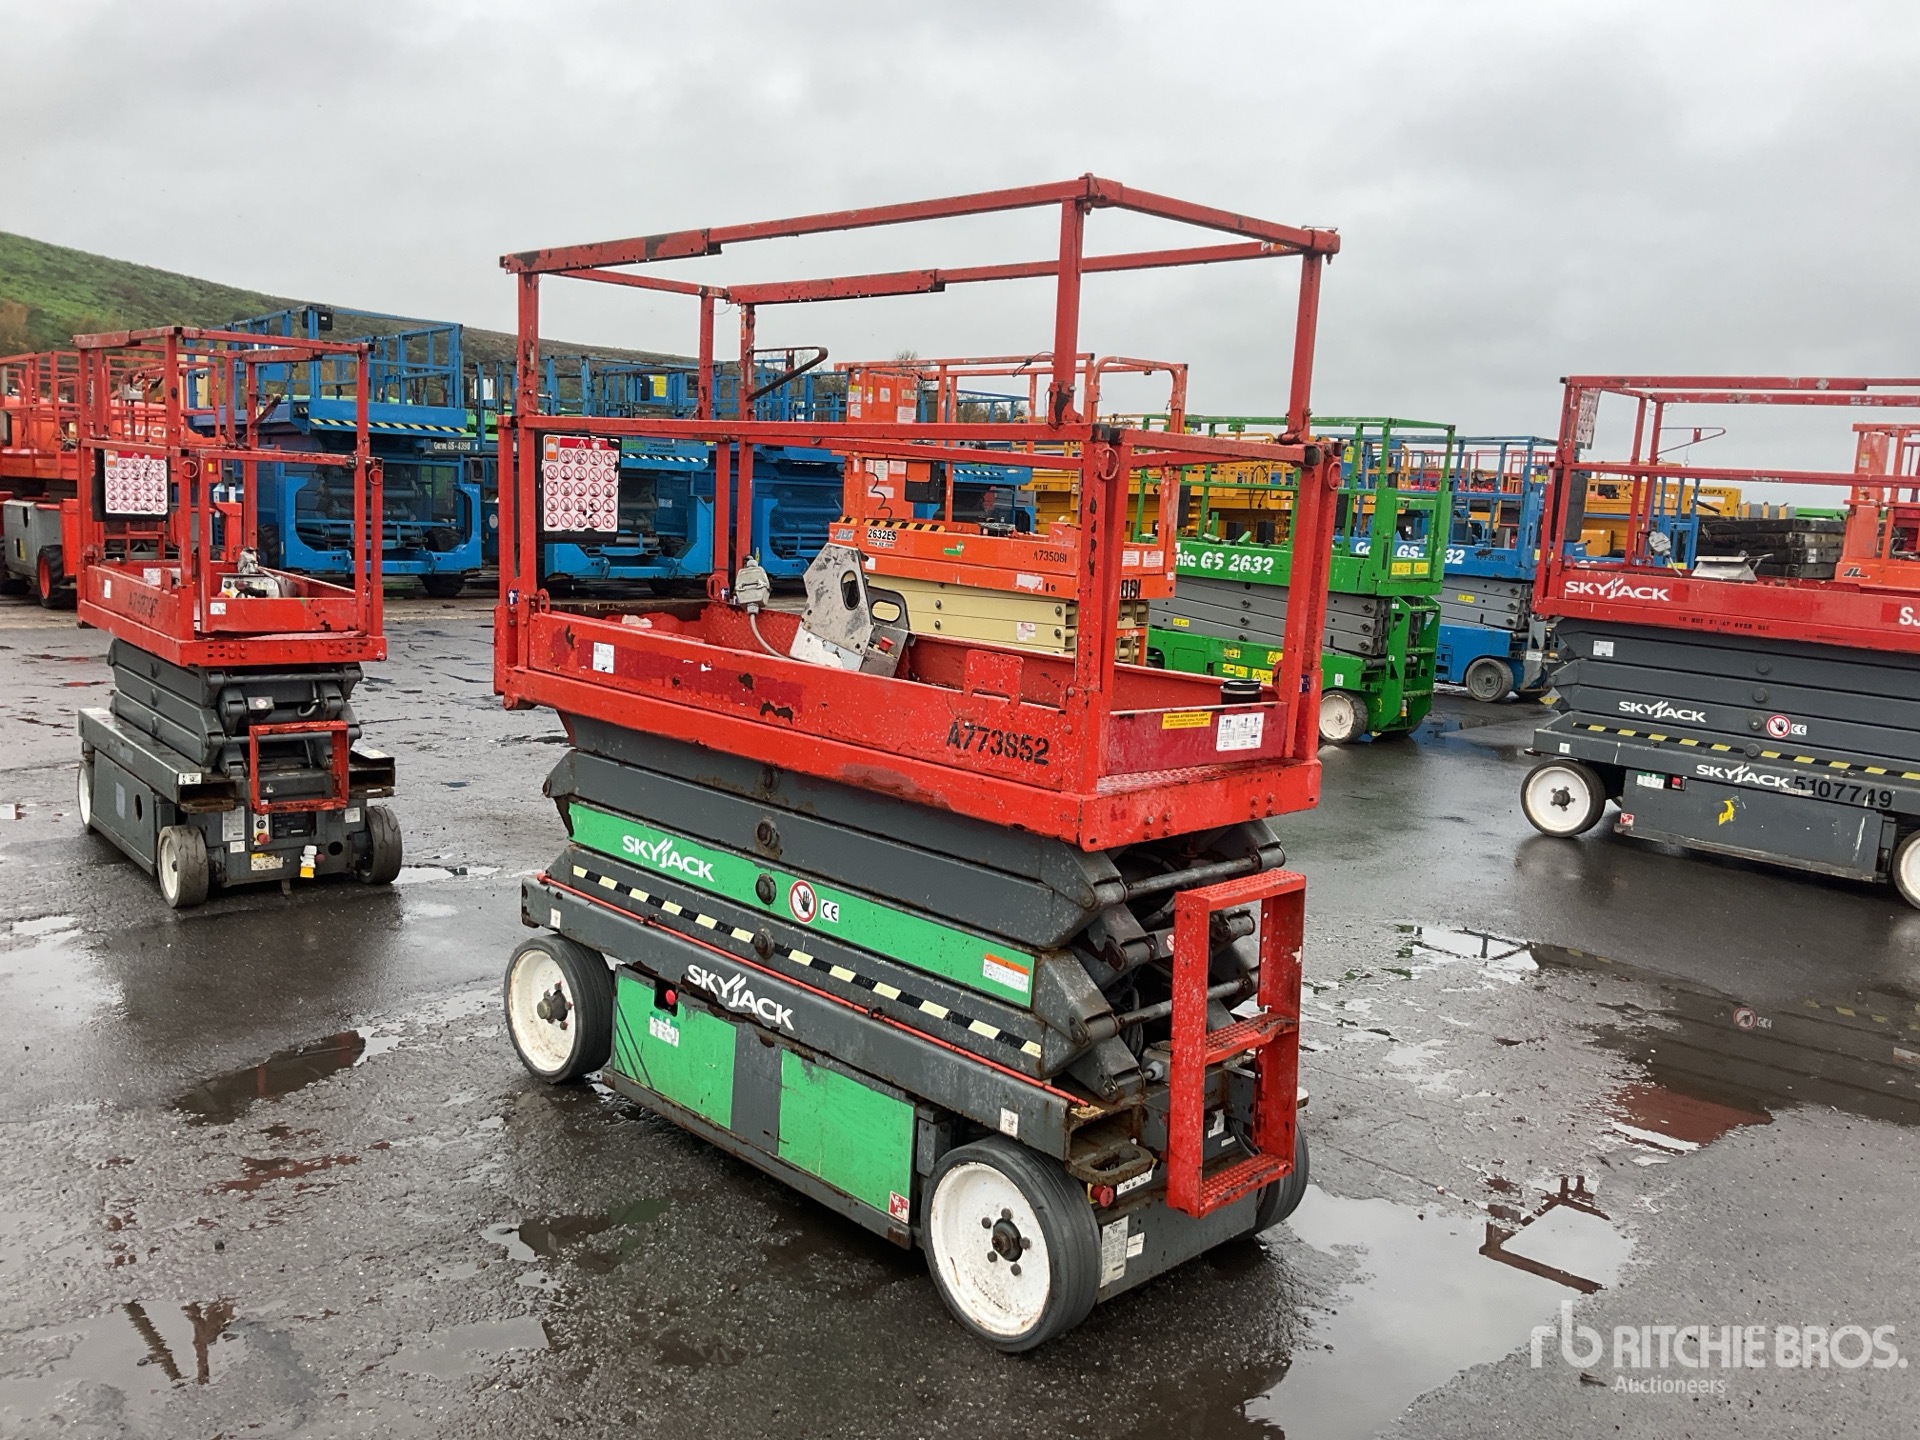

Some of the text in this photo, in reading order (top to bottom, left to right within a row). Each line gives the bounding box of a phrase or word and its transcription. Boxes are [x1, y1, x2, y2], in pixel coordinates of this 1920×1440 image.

[835, 528, 855, 541] JLG
[867, 528, 897, 541] 2632ES
[1200, 551, 1225, 570] GS
[1228, 553, 1274, 575] 2632
[1565, 577, 1671, 602] SKYJACK
[1618, 700, 1707, 723] SKYJACK
[1792, 725, 1806, 735] CE
[945, 720, 1050, 767] A773852
[1696, 764, 1790, 788] SKYJACK
[1793, 776, 1893, 808] 5107749
[621, 834, 715, 883] SKYJACK
[822, 902, 838, 921] CE
[686, 964, 795, 1031] SKYJACK
